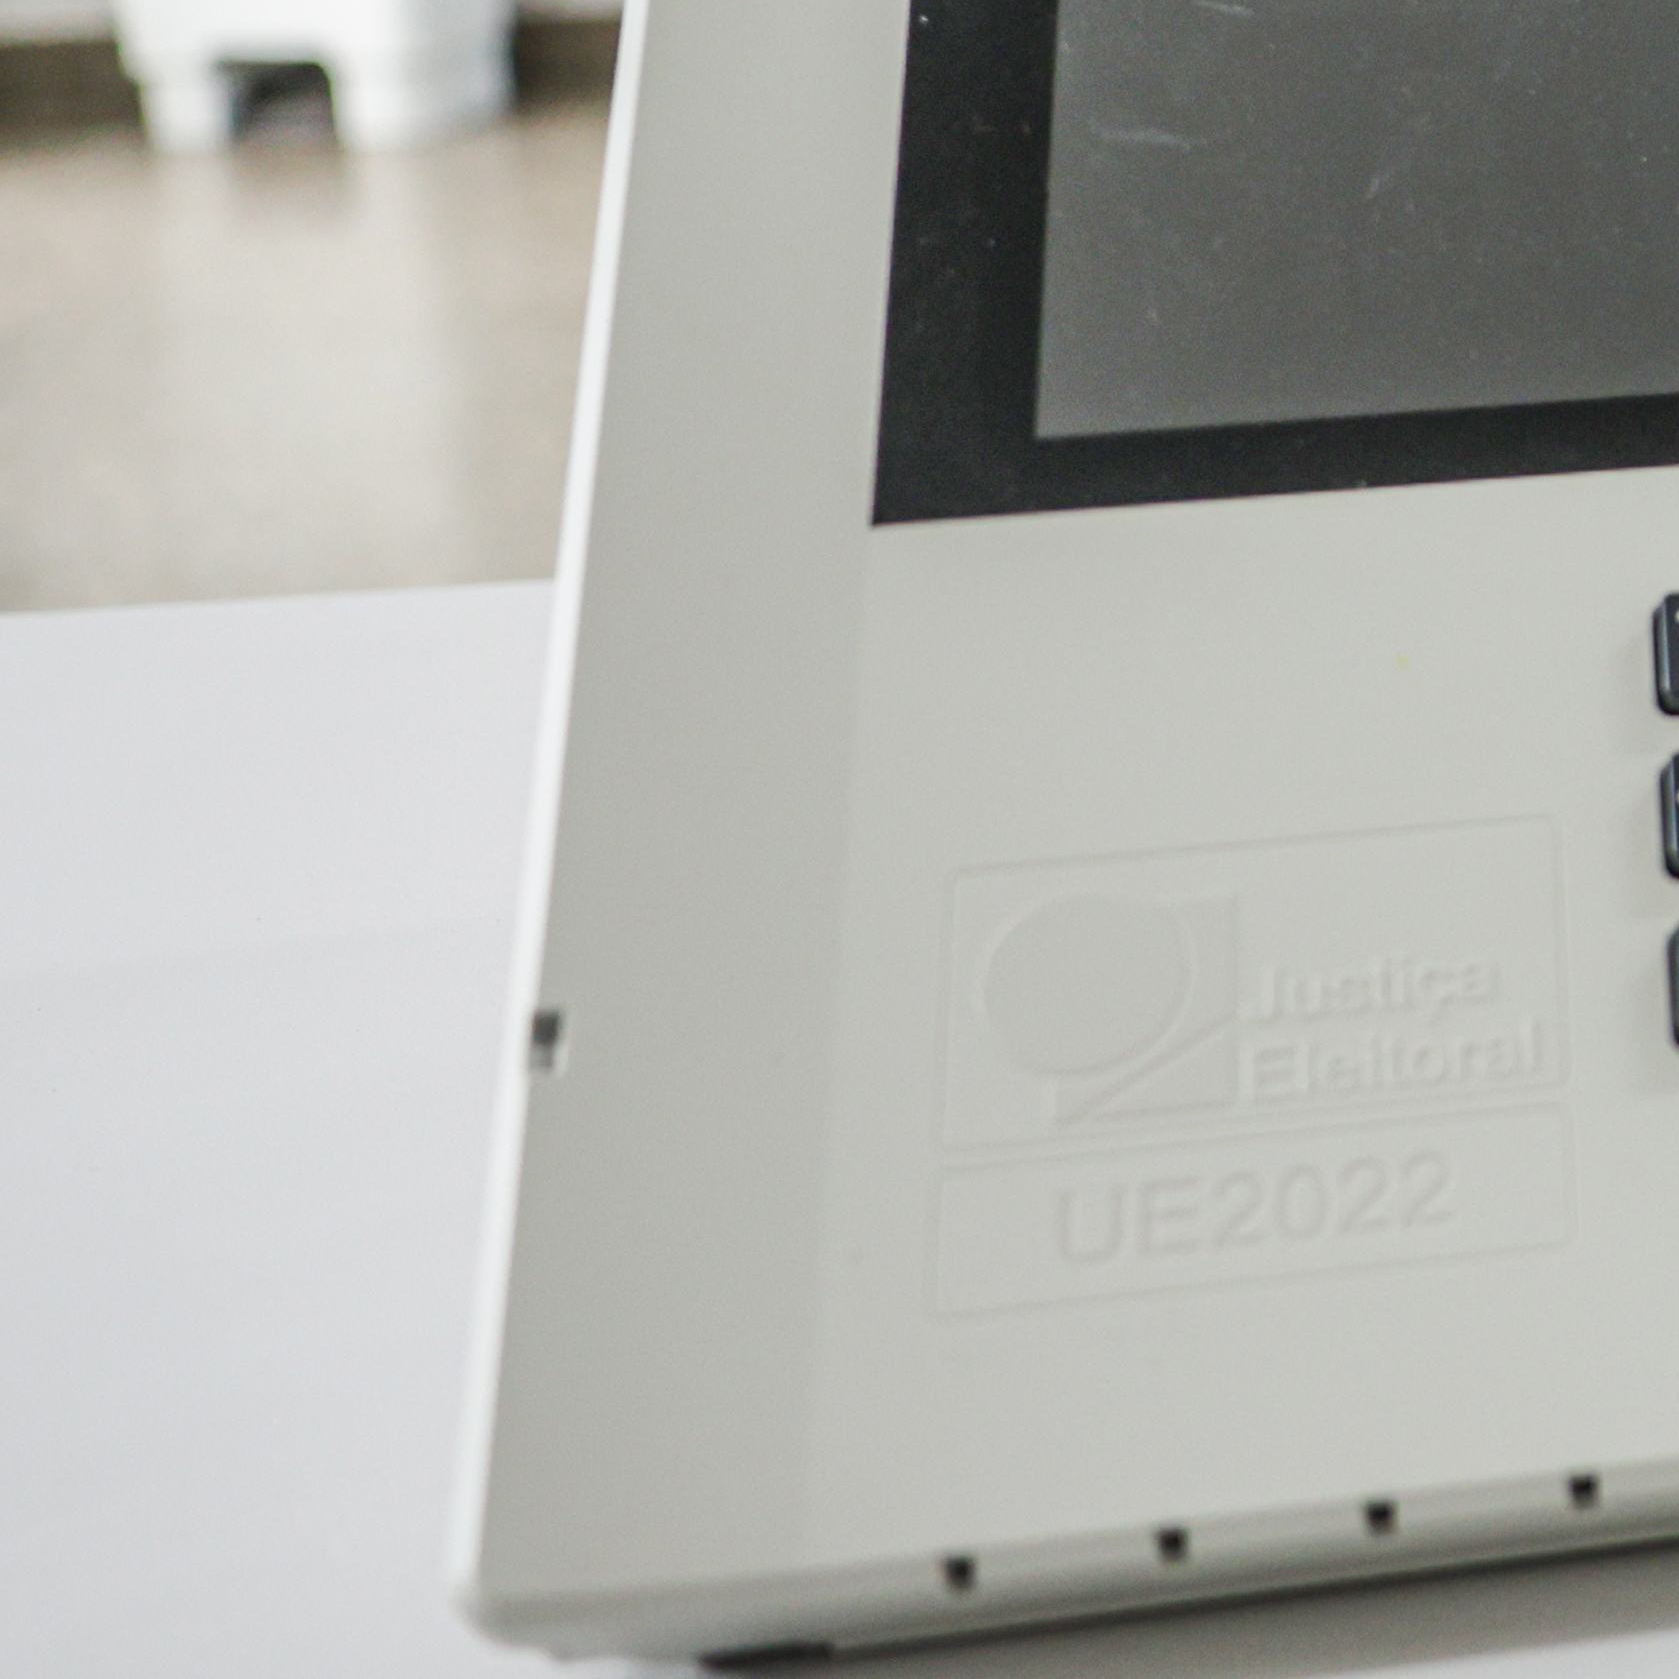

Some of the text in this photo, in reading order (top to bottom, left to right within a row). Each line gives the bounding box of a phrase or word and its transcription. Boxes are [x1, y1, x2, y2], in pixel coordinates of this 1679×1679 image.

[1252, 958, 1500, 1025] Justiça
[1238, 1018, 1544, 1105] Eleitoral
[1056, 1149, 1454, 1264] UE2022
